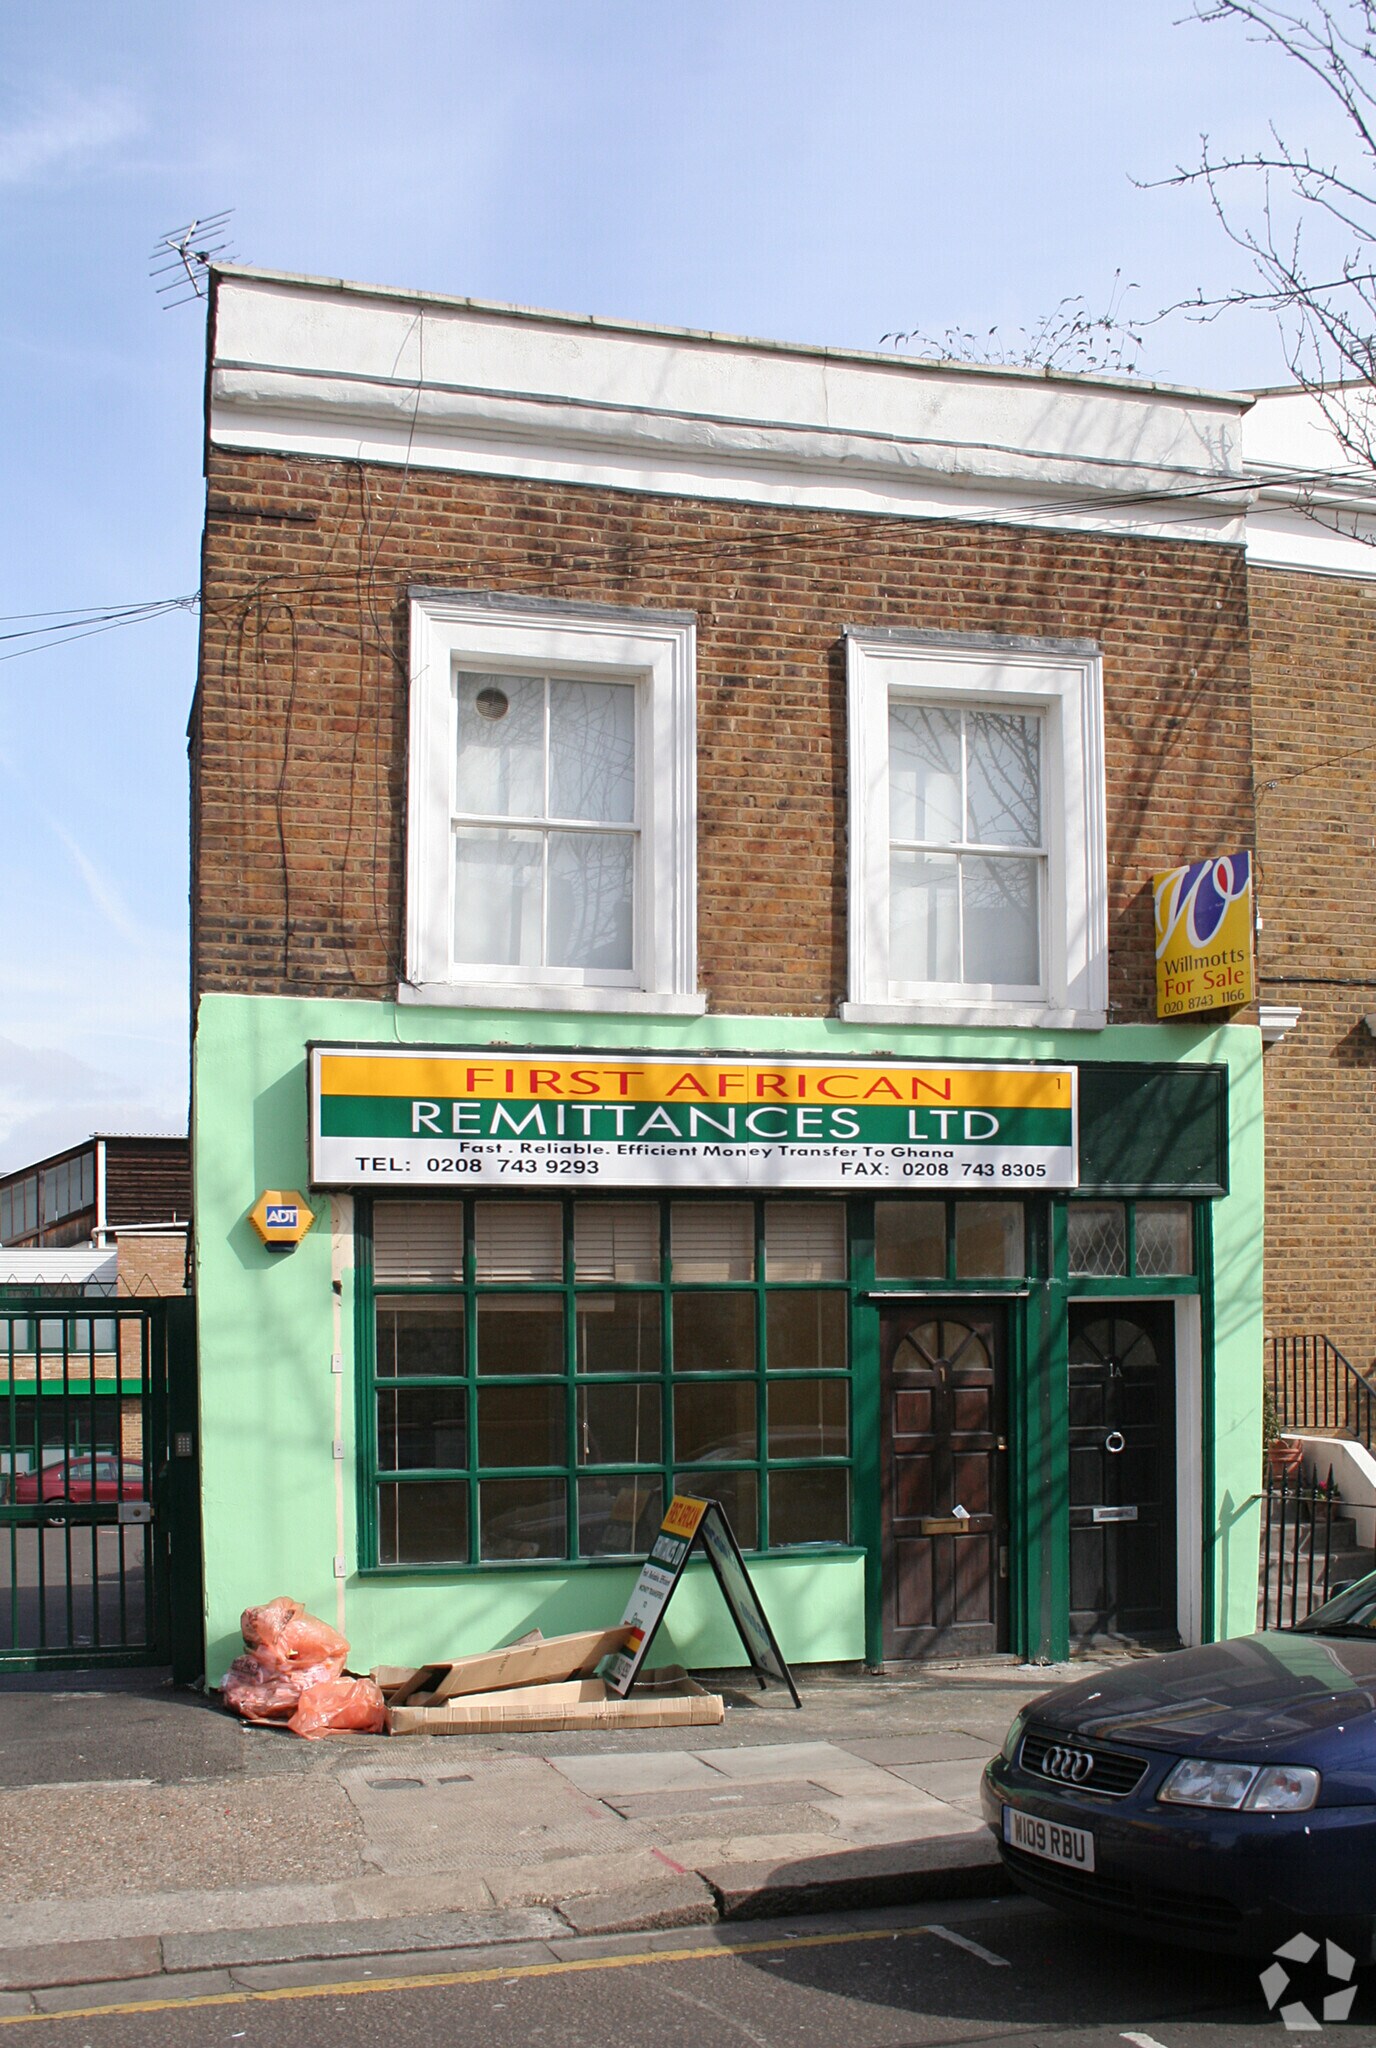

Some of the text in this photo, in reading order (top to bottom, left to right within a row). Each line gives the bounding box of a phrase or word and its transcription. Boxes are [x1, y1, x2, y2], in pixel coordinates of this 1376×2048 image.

[1164, 948, 1245, 976] Willmotts
[1164, 966, 1245, 998] For Sale
[1163, 989, 1245, 1014] 020 8743 1166
[466, 1068, 951, 1100] FIRST AFRICAN
[412, 1101, 1000, 1140] REMITTANCES LTD
[520, 1142, 610, 1155] Reliable.
[617, 1144, 698, 1156] Efficient
[703, 1145, 772, 1160] Money
[778, 1145, 858, 1157] Transfer
[862, 1146, 886, 1158] To
[890, 1147, 954, 1159] Ghana
[355, 1156, 600, 1175] TEL: 0208 743 9293
[841, 1161, 1047, 1178] FAX: 0208 743 8305
[266, 1209, 297, 1223] ADT
[1050, 1825, 1085, 1862] RBU
